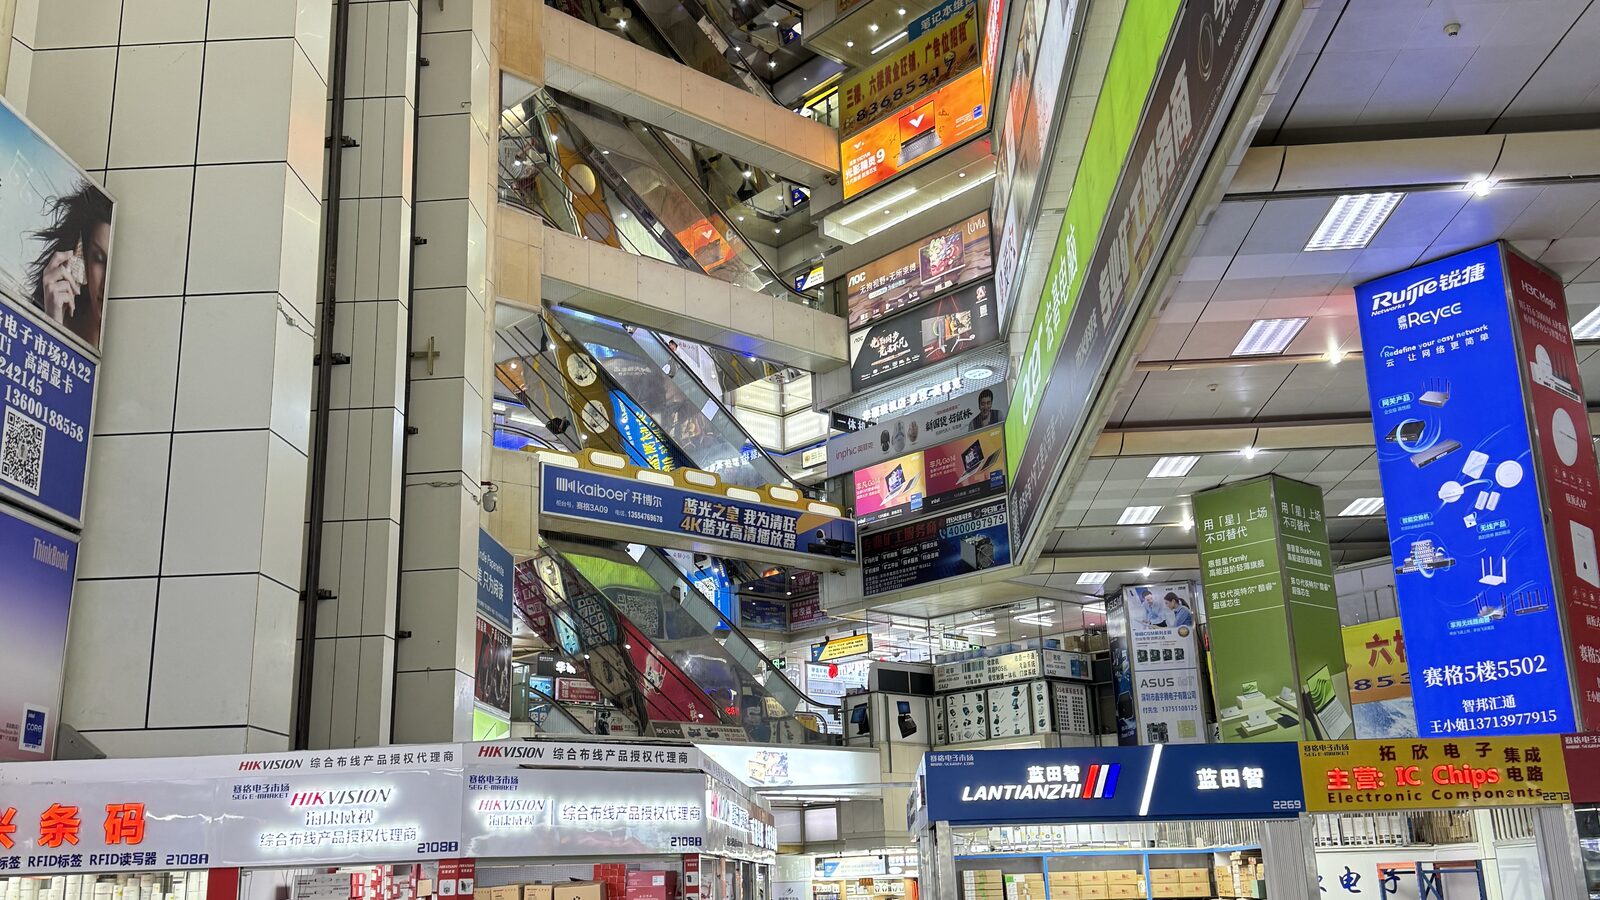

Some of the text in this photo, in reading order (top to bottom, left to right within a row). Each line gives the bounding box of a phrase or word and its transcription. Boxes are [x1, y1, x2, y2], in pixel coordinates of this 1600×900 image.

[921, 0, 974, 30] 笔记本维
[1099, 59, 1192, 327] 专业矿工服务商
[848, 271, 866, 288] AOC
[1371, 262, 1486, 311] Ruijie 锐捷
[1521, 279, 1540, 300] H3C
[1371, 303, 1406, 317] Networks
[0, 309, 91, 384] 电子市场3A22
[1384, 324, 1488, 358] Redefine your easy network
[1386, 333, 1490, 367] 云 让网络更简单
[23, 351, 74, 394] 高端显卡
[5, 385, 84, 443] 13600188558
[577, 481, 662, 508] kaiboer 开博尔
[682, 497, 739, 522] 蓝光之皇
[681, 516, 796, 550] 4K蓝光高清播放器
[948, 514, 1005, 536] 4000097979
[1282, 516, 1311, 533] 不可替代
[1205, 526, 1248, 545] 不可替代
[33, 537, 70, 571] ThinkBook
[1228, 554, 1248, 564] Family
[1423, 654, 1548, 689] 赛格5楼5502
[1140, 678, 1174, 688] ASUS
[1461, 694, 1516, 714] 智邦汇通
[1429, 709, 1557, 734] 王小姐13713977915
[238, 751, 454, 771] HIKVISION 综合布线产品授权代理商
[478, 746, 688, 764] HIKVISION 综合布线产品授权代理商
[1379, 742, 1492, 762] 拓欣电子
[1504, 747, 1541, 763] 集成
[469, 775, 519, 785] 赛格电子市场
[1027, 765, 1080, 783] 蓝田智
[1196, 766, 1264, 790] 蓝田智
[1396, 766, 1423, 785] IC
[1432, 764, 1501, 789] Chips
[1507, 766, 1544, 782] 电路
[233, 784, 290, 793] 赛格电子市场
[290, 788, 391, 806] HIKVISION
[961, 783, 1082, 801] LANTIANZHI
[1328, 787, 1543, 804] Electronic Components
[1542, 792, 1570, 801] 2273
[478, 799, 701, 821] HIKVISION 综合布线产品授权代理商
[1273, 800, 1301, 809] 2269
[260, 828, 417, 847] 综合布线产品授权代理商
[417, 841, 458, 853] 2108B
[671, 837, 702, 847] 2108B
[28, 854, 83, 868] RFID标签
[89, 852, 157, 866] RFID读写器
[166, 854, 209, 866] 2108A
